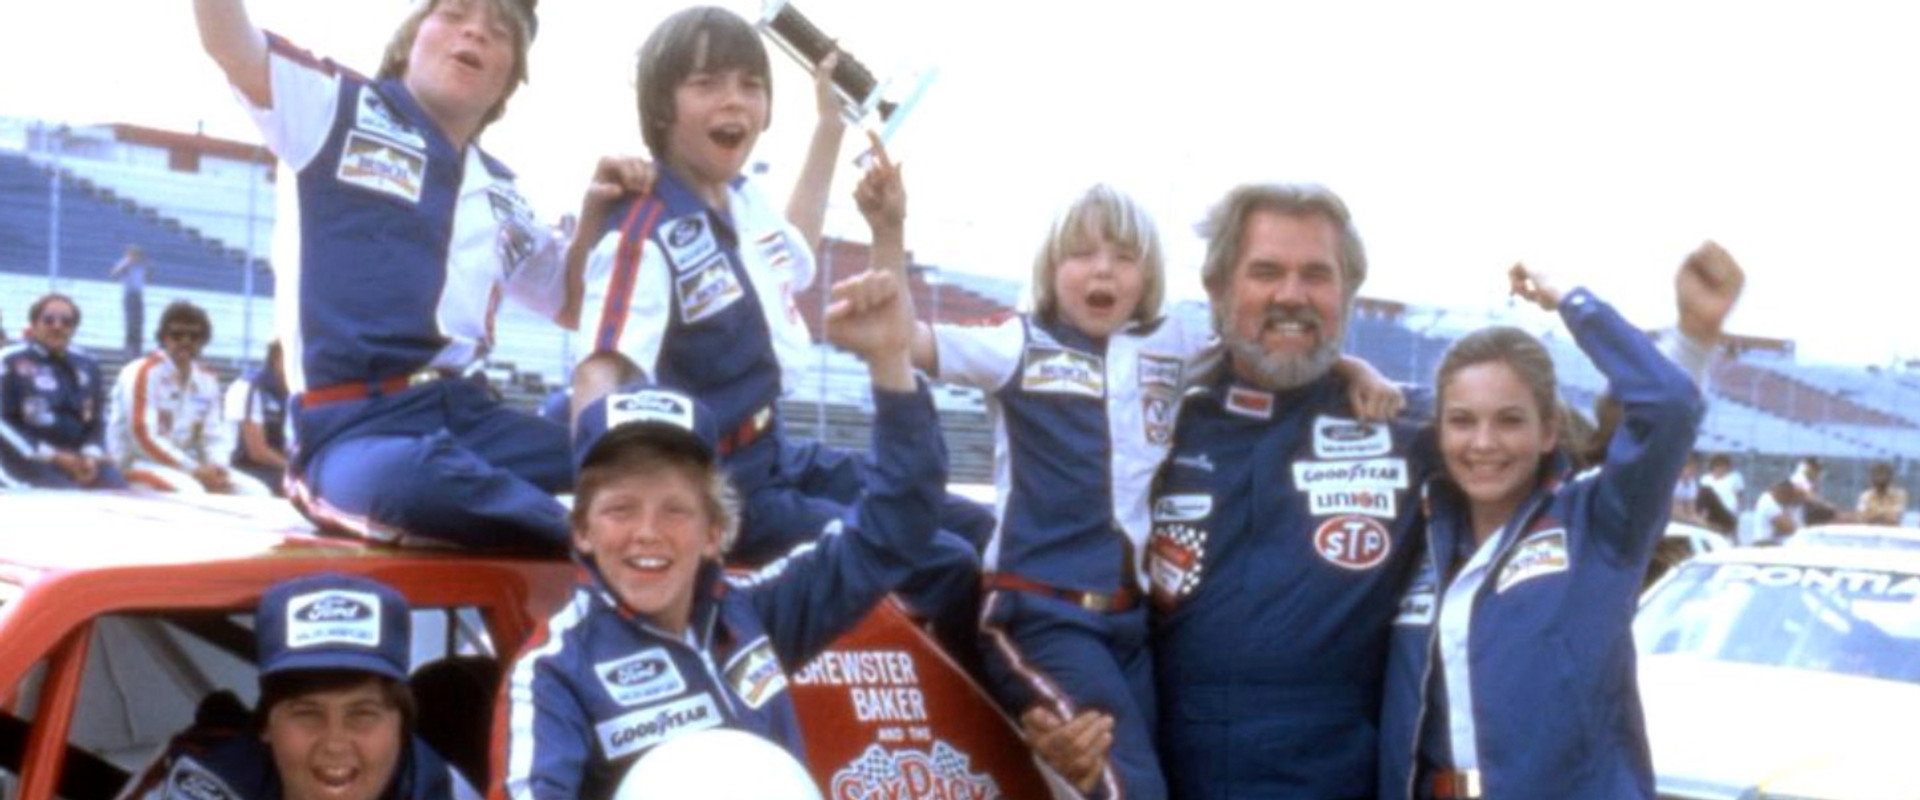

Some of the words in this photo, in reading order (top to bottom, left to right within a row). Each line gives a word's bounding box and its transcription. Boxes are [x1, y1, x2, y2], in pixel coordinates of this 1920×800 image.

[1303, 464, 1398, 482] GOODYEAR
[1326, 522, 1381, 560] STP
[308, 598, 359, 619] Ford
[616, 660, 656, 684] Ford
[851, 687, 927, 722] BAKER
[611, 704, 708, 746] GOODYEAR
